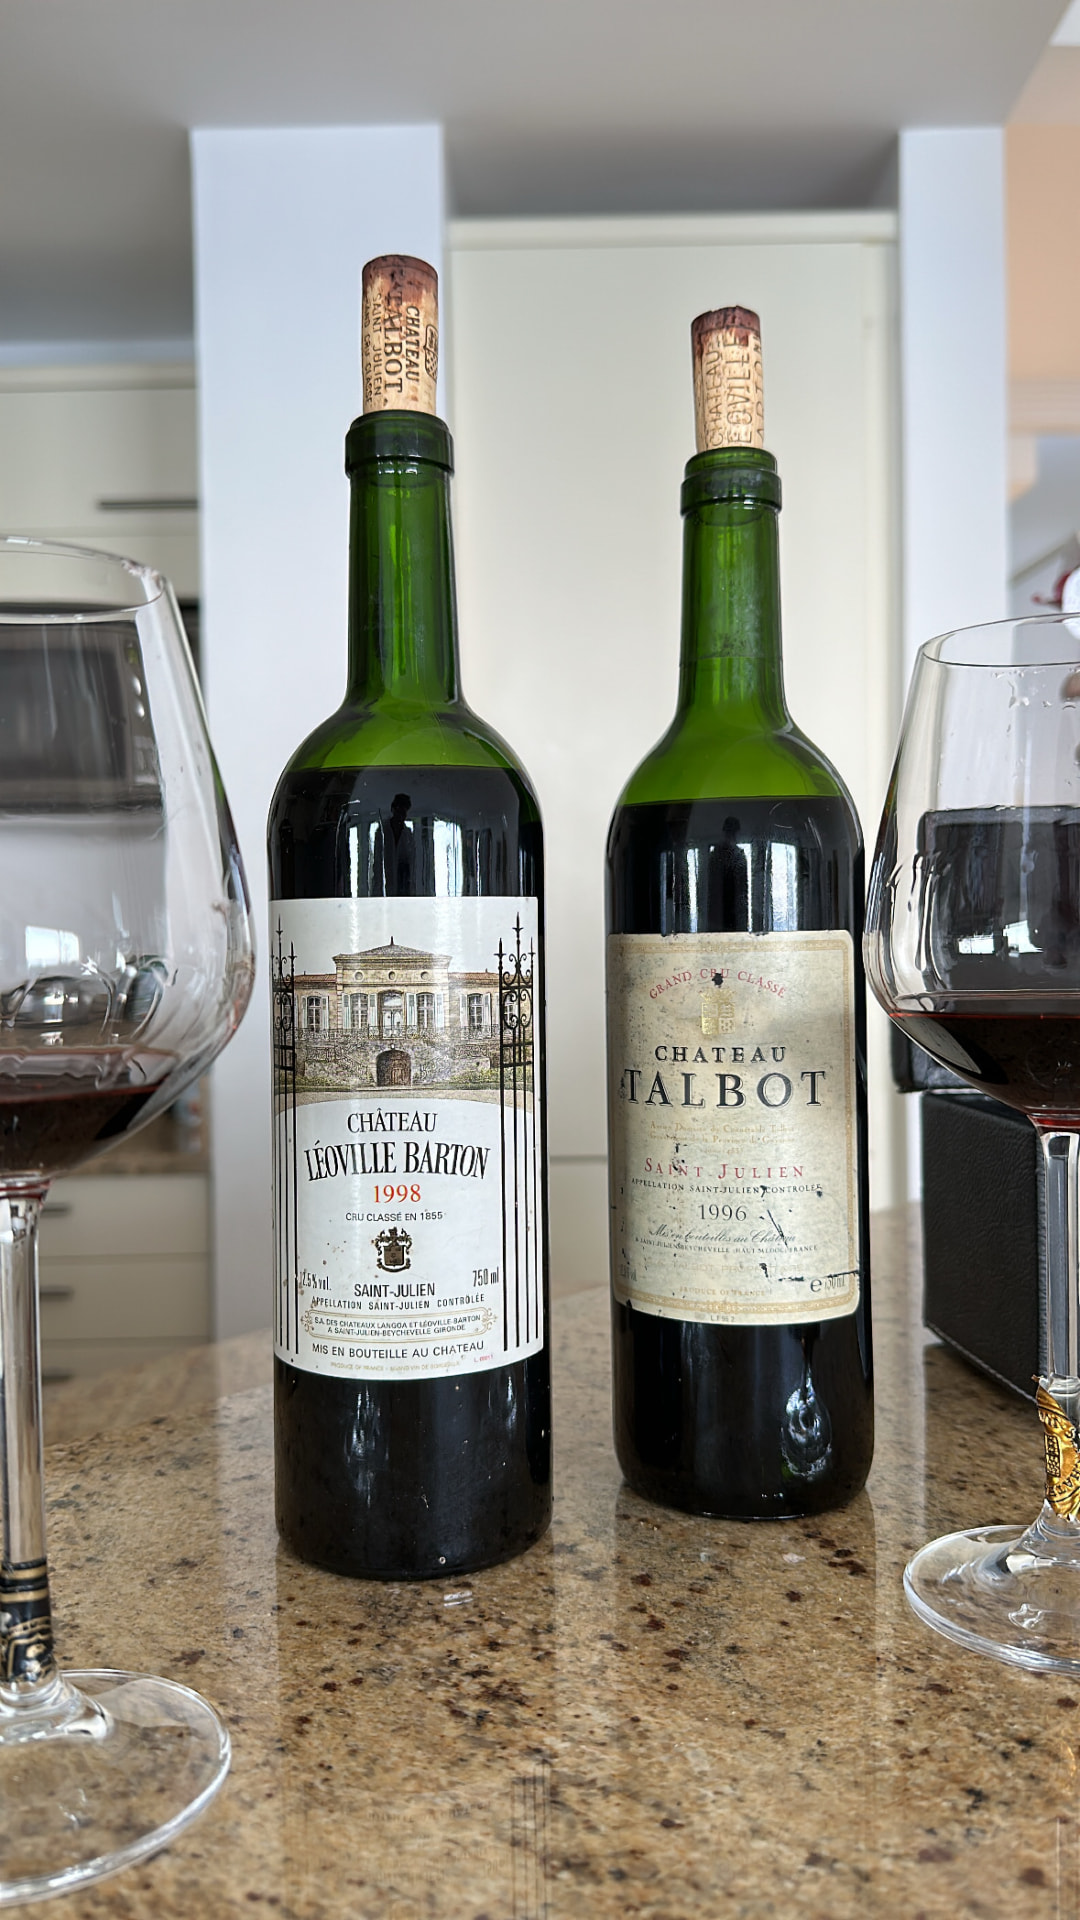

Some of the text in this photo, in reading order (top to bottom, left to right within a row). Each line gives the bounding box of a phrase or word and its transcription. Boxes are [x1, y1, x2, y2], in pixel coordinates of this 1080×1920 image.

[405, 306, 420, 382] CHATEAU
[649, 971, 692, 1000] GRAND
[654, 1045, 787, 1063] CHATEAU
[624, 1069, 826, 1109] TALBOT
[347, 1107, 438, 1133] CHÂTEAU
[304, 1140, 491, 1181] LÉOVILLE BARTON
[373, 1183, 421, 1203] 1998
[631, 1178, 685, 1191] APPELLATION
[345, 1210, 443, 1222] CRU CLASSÉ EN 1855
[698, 1203, 747, 1222] 1996
[473, 1267, 499, 1287] 750 ml
[354, 1283, 435, 1298] SAINT-JULIEN
[311, 1293, 485, 1310] APPELLATION SAINT-JULIEN CONTRÔLÉE
[326, 1318, 338, 1326] DES
[340, 1320, 376, 1329] CHATEAUX
[377, 1321, 408, 1330] LANGOA
[434, 1325, 466, 1334] GIRONDE
[312, 1341, 484, 1359] MIS EN BOUTEILLE AU CHATEAU
